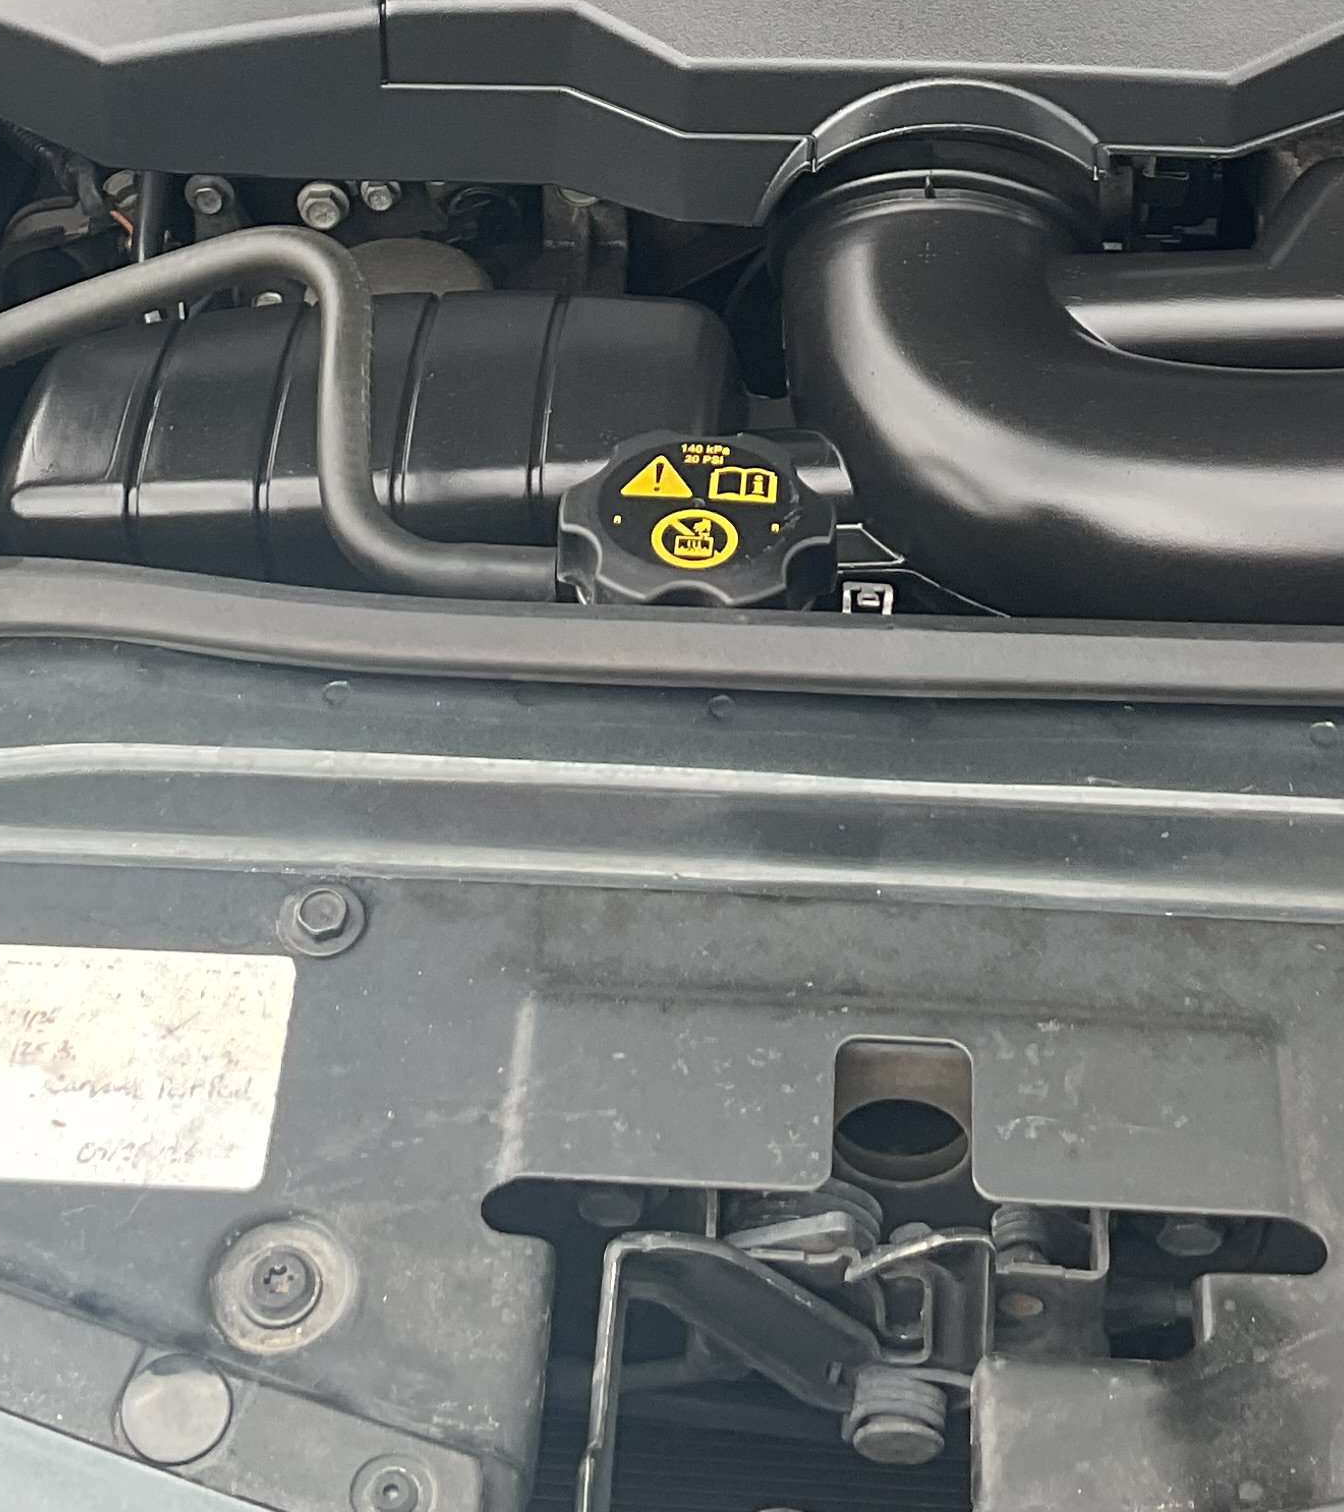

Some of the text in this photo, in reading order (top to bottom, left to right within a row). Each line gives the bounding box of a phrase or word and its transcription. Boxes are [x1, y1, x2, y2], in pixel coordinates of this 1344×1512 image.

[681, 443, 731, 456] 140 kPa
[683, 454, 724, 465] 20 PSI
